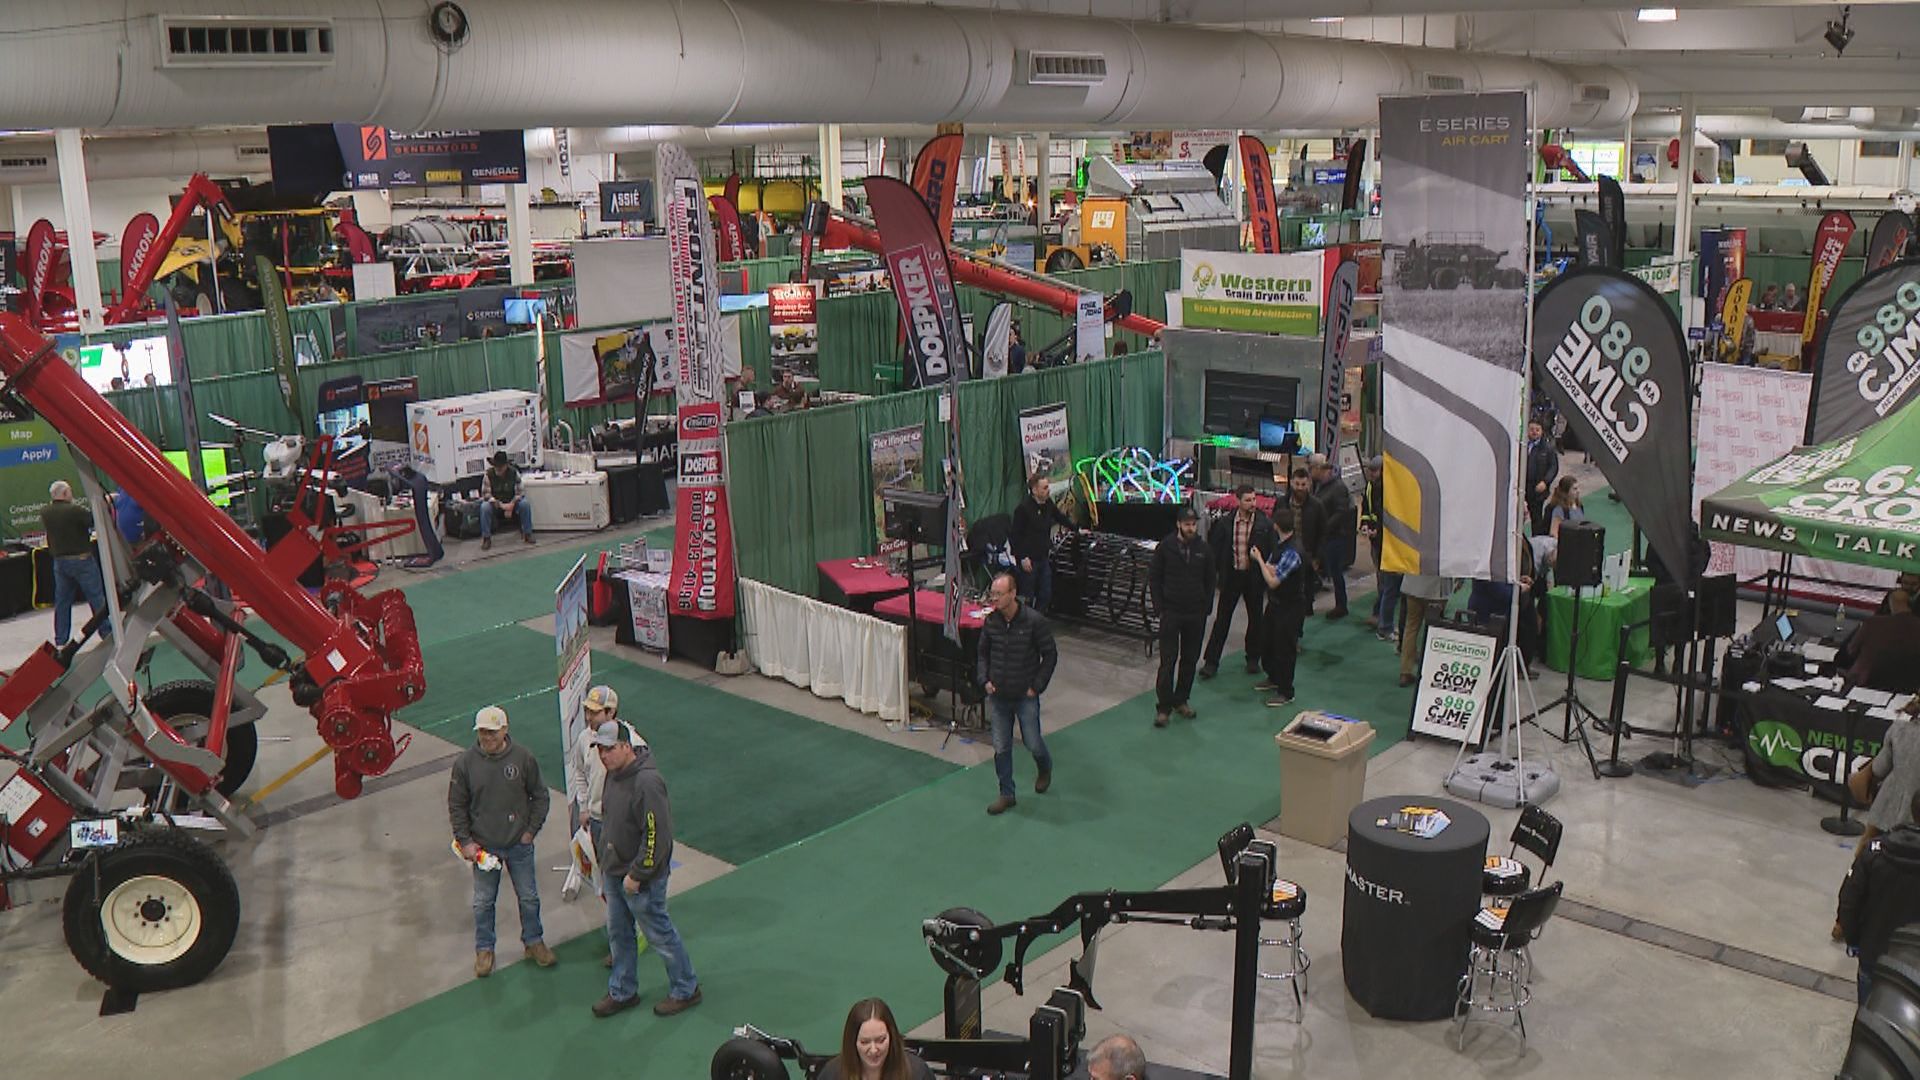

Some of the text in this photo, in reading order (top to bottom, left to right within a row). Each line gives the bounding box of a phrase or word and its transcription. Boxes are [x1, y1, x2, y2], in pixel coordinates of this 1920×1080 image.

[1419, 116, 1510, 132] E SERIES
[394, 143, 478, 154] GENERATORS
[1441, 134, 1510, 146] AIR CART
[472, 167, 519, 177] GENERAC
[128, 223, 155, 280] AKRON
[32, 231, 54, 301] AKRON
[684, 187, 710, 393] FRONTLINE
[1220, 273, 1312, 292] Western
[1225, 289, 1308, 303] Grain Dryer Inc.
[898, 255, 948, 377] DOEPKER
[1194, 304, 1217, 313] Grain
[1219, 305, 1251, 316] Drying
[1858, 311, 1920, 402] CJM
[437, 408, 464, 416] AIRMAN
[10, 430, 33, 440] Map
[22, 448, 52, 461] Apply
[684, 456, 719, 473] DOEPKER
[1711, 513, 1798, 543] NEWS
[1834, 533, 1917, 559] TALK
[697, 490, 718, 612] SASKATOON
[1433, 641, 1487, 656] ON LOCATION
[1450, 661, 1481, 678] 650
[1433, 671, 1478, 690] CKOM
[1444, 695, 1476, 712] 980
[1428, 705, 1472, 725] CJME
